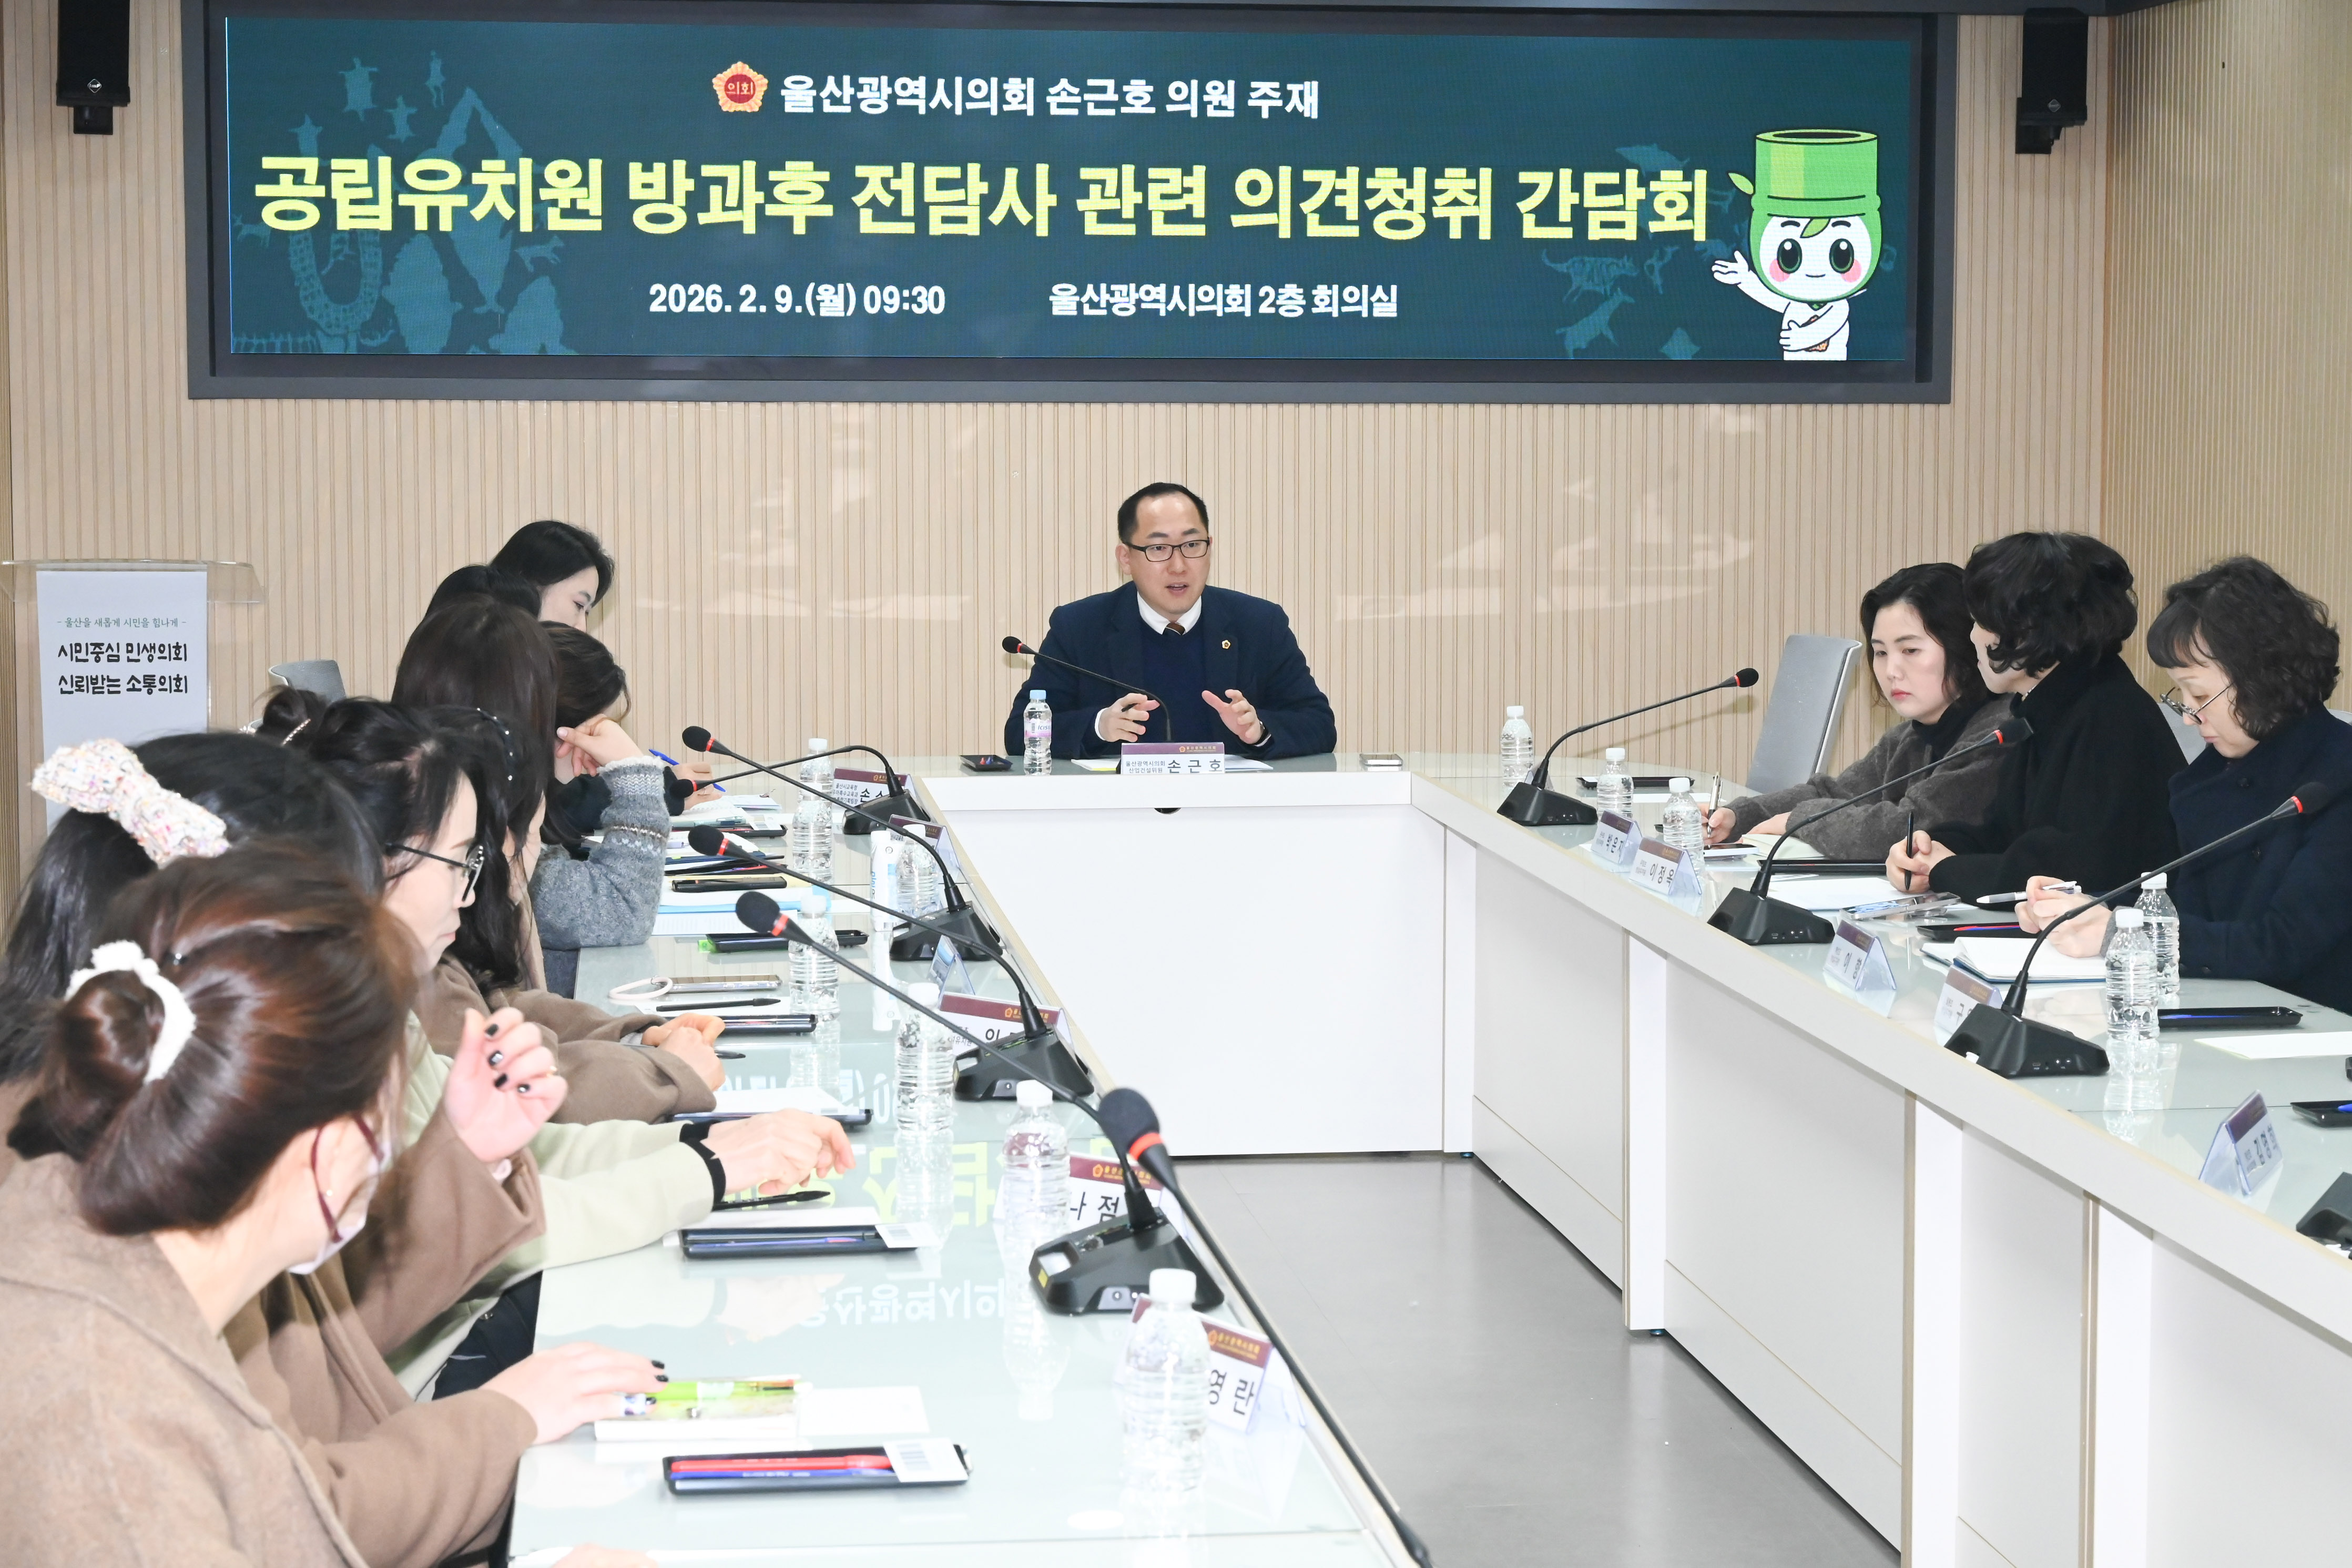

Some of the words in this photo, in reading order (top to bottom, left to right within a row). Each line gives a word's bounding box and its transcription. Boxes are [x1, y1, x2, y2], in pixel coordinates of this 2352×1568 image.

[726, 81, 754, 95] 의회
[781, 75, 1035, 117] 울산광역시의회
[1046, 78, 1156, 116] 손근호
[1166, 79, 1236, 118] 의원
[1248, 81, 1319, 119] 주재
[256, 157, 603, 233] 공립유치원
[629, 160, 834, 236] 방과후
[851, 162, 1057, 237] 전담사
[1077, 165, 1207, 237] 관련
[1231, 166, 1493, 240] 의견청취
[1517, 168, 1708, 242] 간담회
[649, 283, 732, 313] 2026.
[739, 284, 767, 313] 2.
[775, 282, 857, 318] 9.(월)
[864, 286, 946, 315] 09:30
[1050, 283, 1252, 318] 울산광역시의회
[1259, 284, 1306, 318] 2층
[1312, 284, 1398, 318] 회의실
[65, 618, 91, 628] 울산을
[95, 618, 120, 628] 새롭게
[124, 618, 150, 628] 시민을
[153, 618, 178, 628] 힘나게
[58, 643, 120, 664] 시민중심
[126, 642, 188, 664] 민생의회
[59, 675, 121, 695] 신뢰받는
[127, 674, 188, 696] 소통의회
